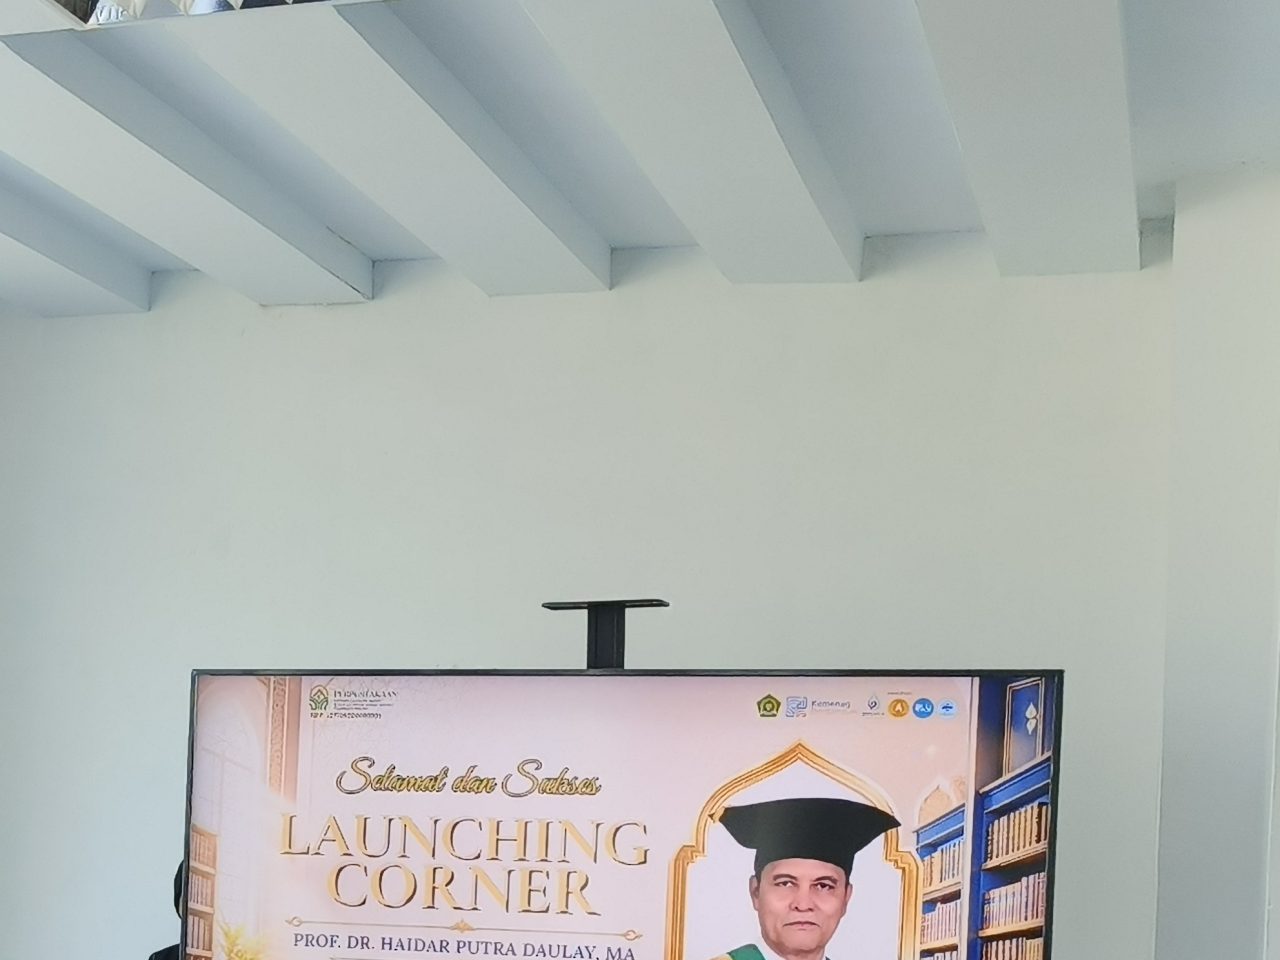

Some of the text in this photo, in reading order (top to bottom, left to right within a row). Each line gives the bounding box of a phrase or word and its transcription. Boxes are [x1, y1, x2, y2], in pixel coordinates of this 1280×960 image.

[335, 756, 602, 798] Selamat dan Sukses
[279, 812, 651, 866] LAUNCHING
[327, 862, 602, 917] CORNER
[293, 933, 341, 949] PROF.
[346, 935, 375, 950] DR.
[381, 936, 450, 954] HAIDAR
[456, 940, 518, 957] PUTRA
